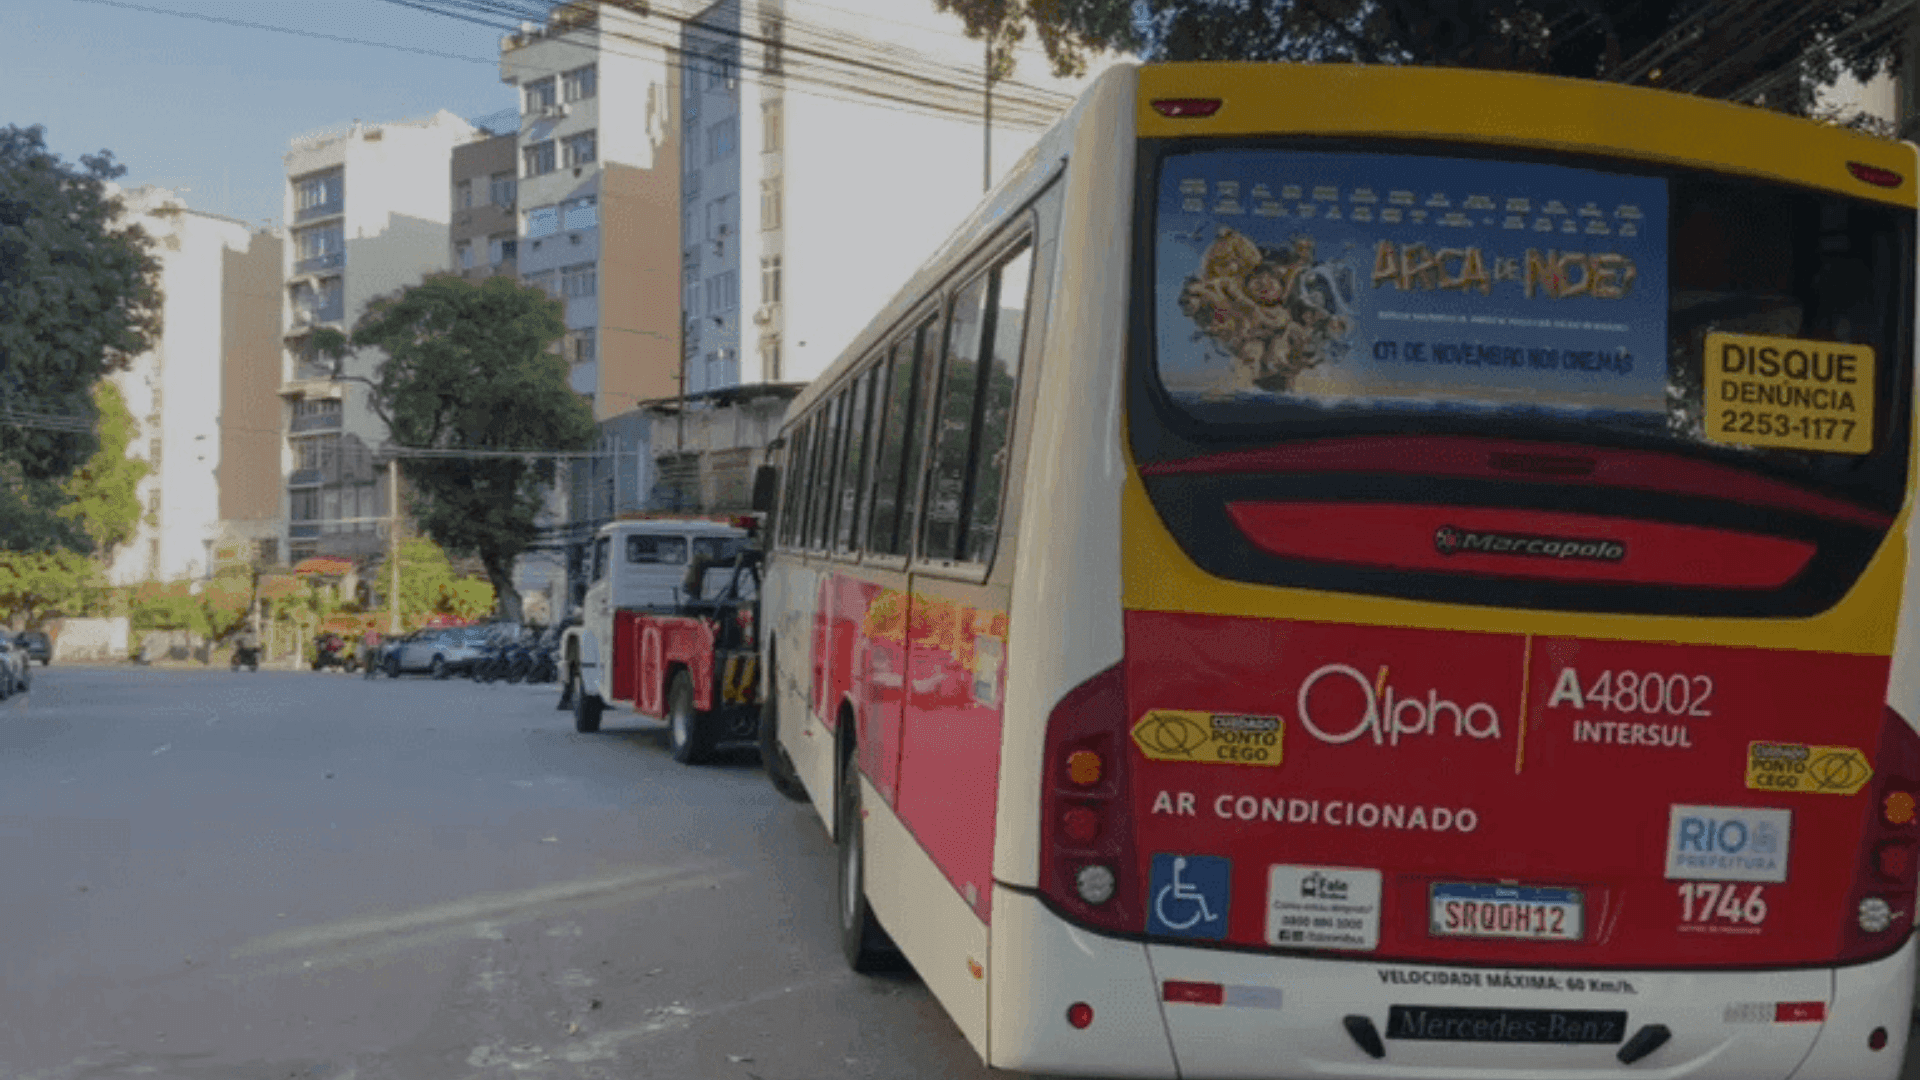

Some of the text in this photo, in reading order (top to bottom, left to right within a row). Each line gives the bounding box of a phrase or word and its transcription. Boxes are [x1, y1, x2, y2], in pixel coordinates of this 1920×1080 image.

[1371, 240, 1491, 297] ARCA
[1404, 342, 1428, 363] DE
[1720, 343, 1857, 384] DISQUE
[1720, 379, 1856, 412] DENÚNCIA
[1720, 409, 1856, 442] 2253-1177
[1463, 533, 1624, 559] Marcopolo
[1548, 667, 1712, 717] A48002
[1211, 729, 1277, 746] PONTO
[1573, 720, 1692, 747] INTERSUL
[1217, 745, 1268, 761] CEGO
[1752, 759, 1806, 774] PONTO
[1756, 773, 1798, 788] CEGO
[1152, 791, 1477, 832] AR CONDICIONADO
[1680, 817, 1748, 854] RIO
[1677, 854, 1777, 870] PREFEITURA
[1678, 882, 1767, 925] 1746
[1378, 970, 1482, 988] VELOCIDADE
[1567, 976, 1586, 991] 60
[1401, 1010, 1615, 1041] Mercedes-Benz
